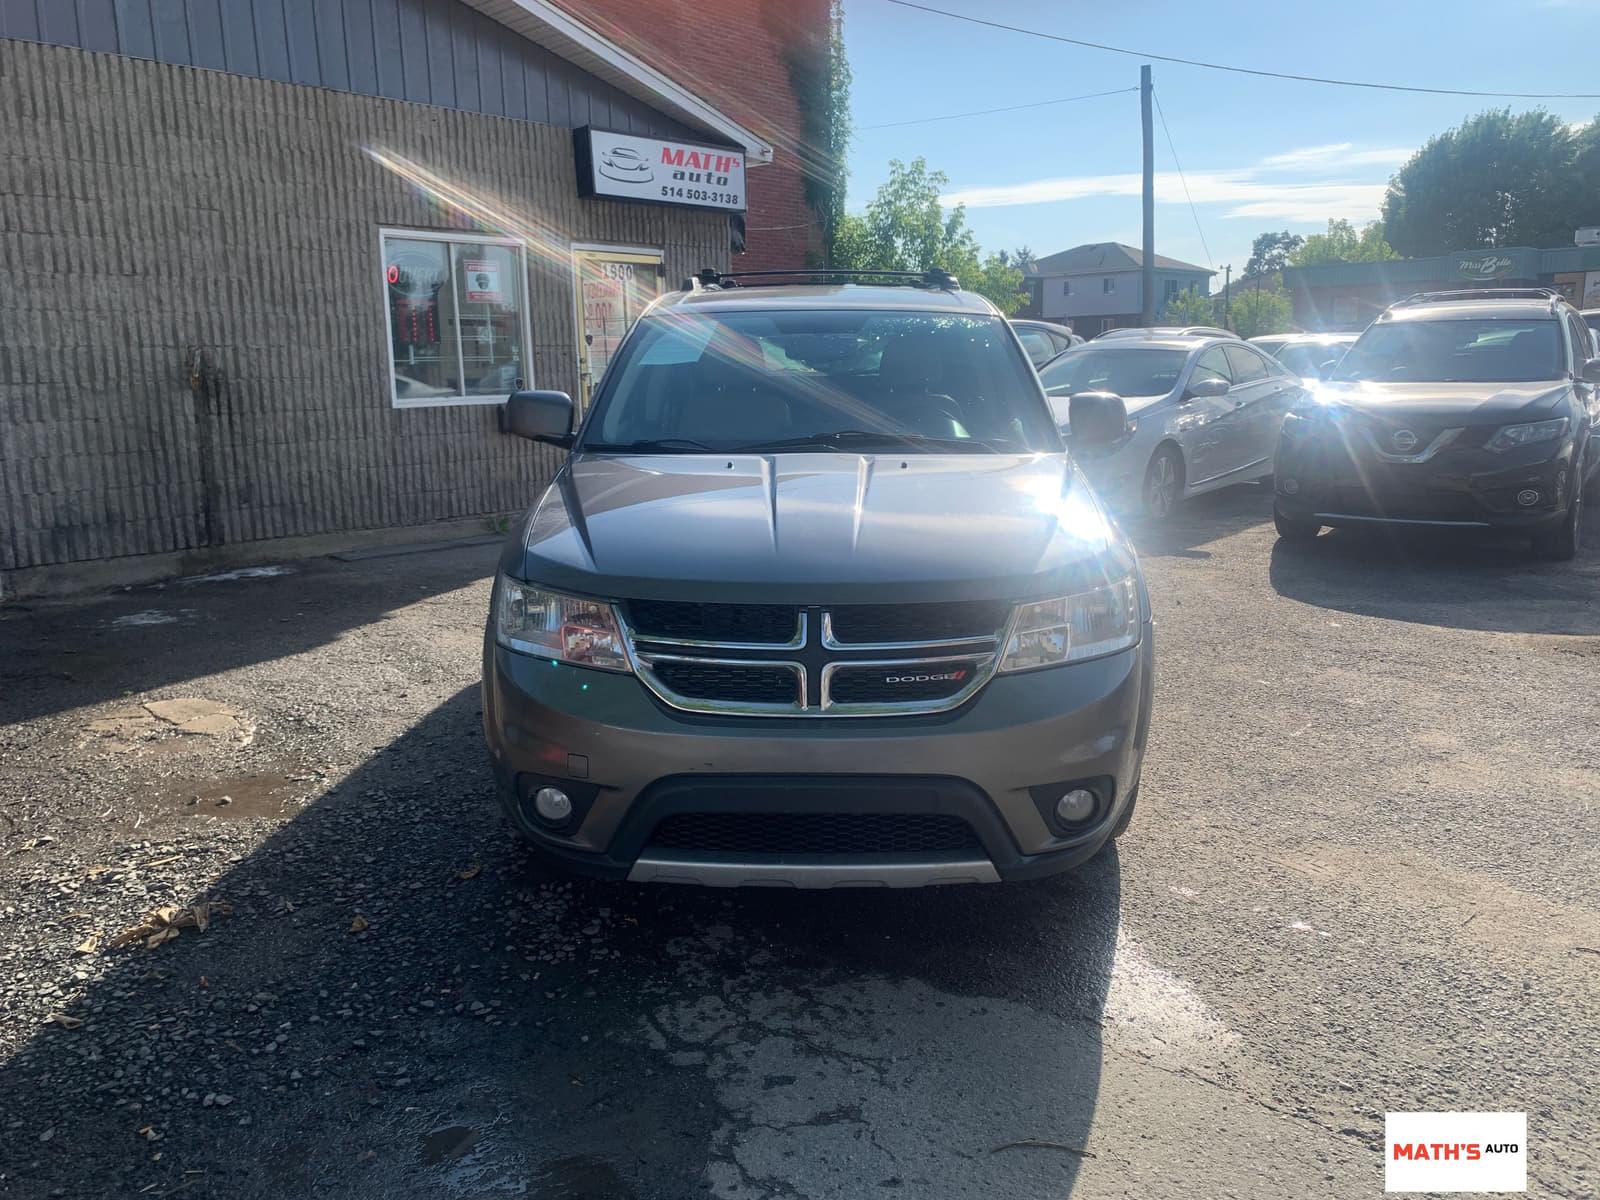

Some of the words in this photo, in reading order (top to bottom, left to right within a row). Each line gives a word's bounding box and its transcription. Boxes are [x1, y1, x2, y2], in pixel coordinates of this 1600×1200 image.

[672, 170, 728, 186] auto
[661, 186, 683, 198] 514
[886, 673, 957, 683] DODGE
